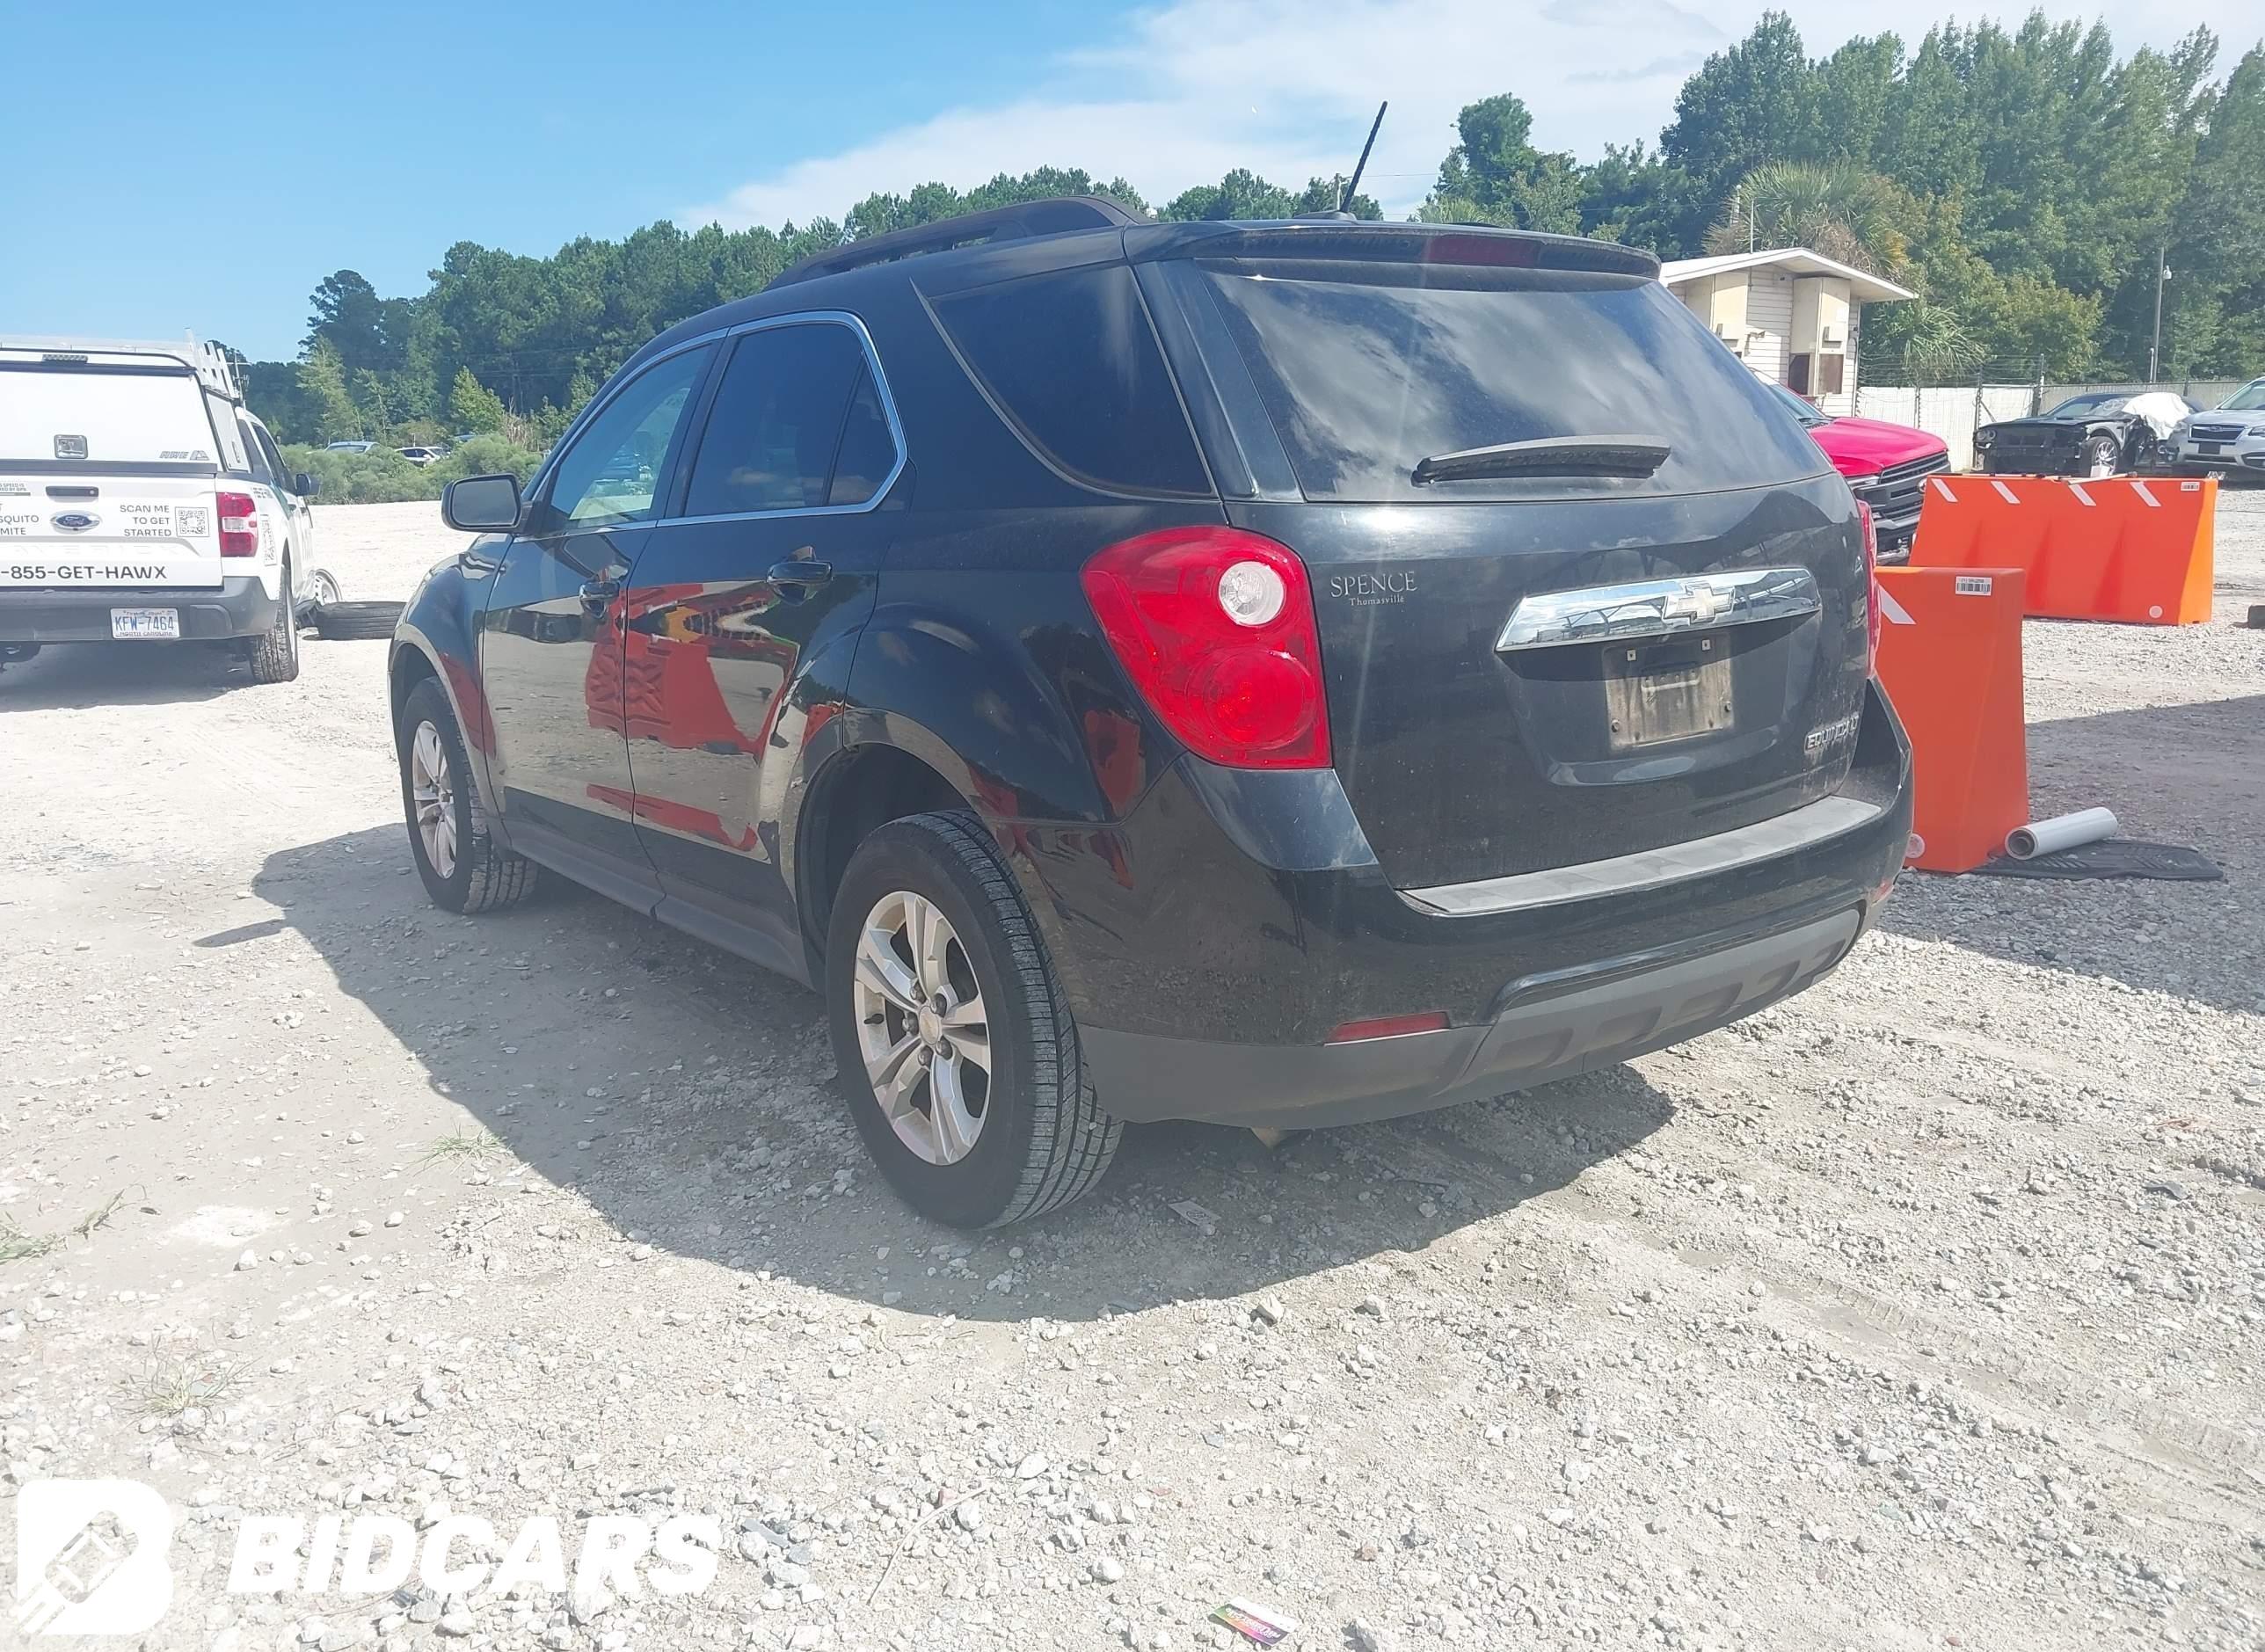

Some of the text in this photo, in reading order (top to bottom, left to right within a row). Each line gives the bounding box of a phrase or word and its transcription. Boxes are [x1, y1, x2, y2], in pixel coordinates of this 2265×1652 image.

[1330, 571, 1418, 598] SPENCE
[1349, 593, 1404, 606] Thomasville
[115, 615, 174, 631] KFW-7464
